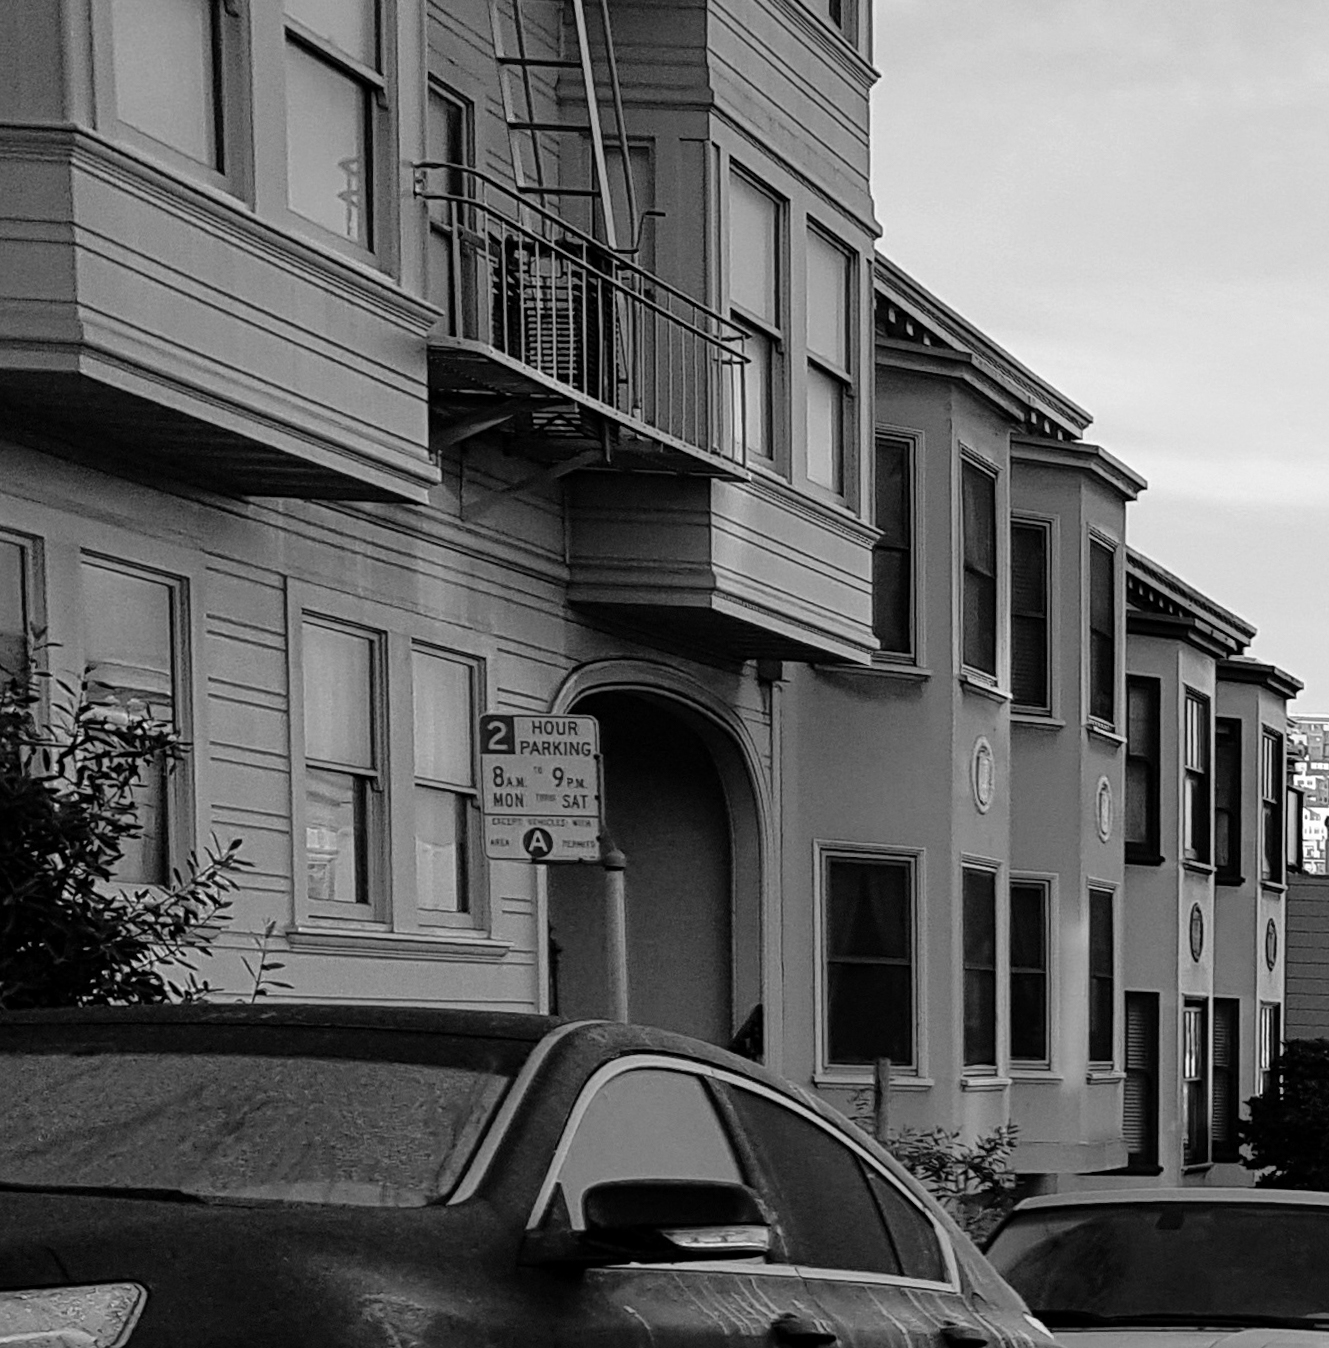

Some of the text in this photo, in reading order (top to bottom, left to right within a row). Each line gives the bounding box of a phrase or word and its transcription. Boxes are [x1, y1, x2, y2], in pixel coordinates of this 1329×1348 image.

[487, 720, 579, 751] 2 HOUR
[519, 740, 592, 757] PARKING
[492, 765, 505, 788] 8
[552, 767, 564, 788] 9
[493, 793, 524, 808] MON
[562, 794, 589, 809] SAT
[528, 830, 549, 853] A
